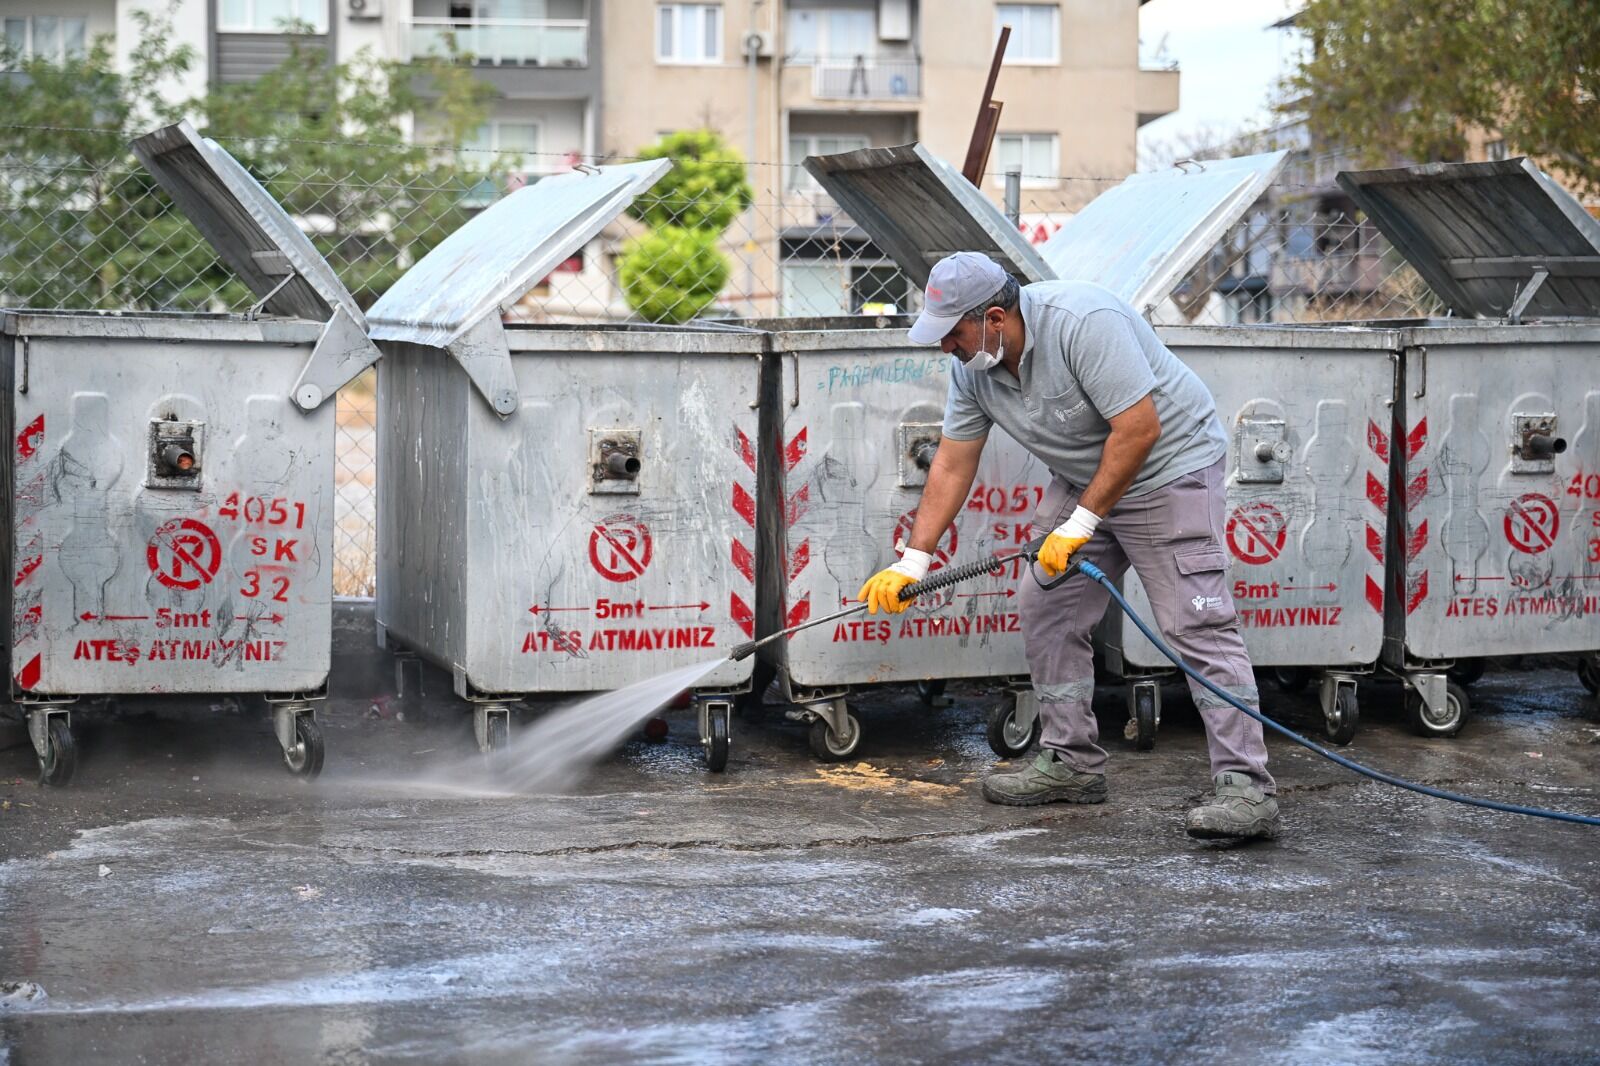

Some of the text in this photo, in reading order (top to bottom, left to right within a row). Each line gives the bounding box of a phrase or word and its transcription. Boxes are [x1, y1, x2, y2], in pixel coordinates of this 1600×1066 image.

[218, 491, 305, 529] 4051
[991, 522, 1034, 545] SK
[250, 537, 300, 563] SK
[239, 570, 291, 603] 32
[1233, 580, 1281, 599] 5mt
[155, 608, 212, 628] 5mt
[594, 598, 645, 619] 5mt
[588, 626, 716, 651] ATMAYINIZ
[832, 613, 1022, 645] ATEŞ ATMAYINIZ
[73, 640, 140, 666] ATEŞ
